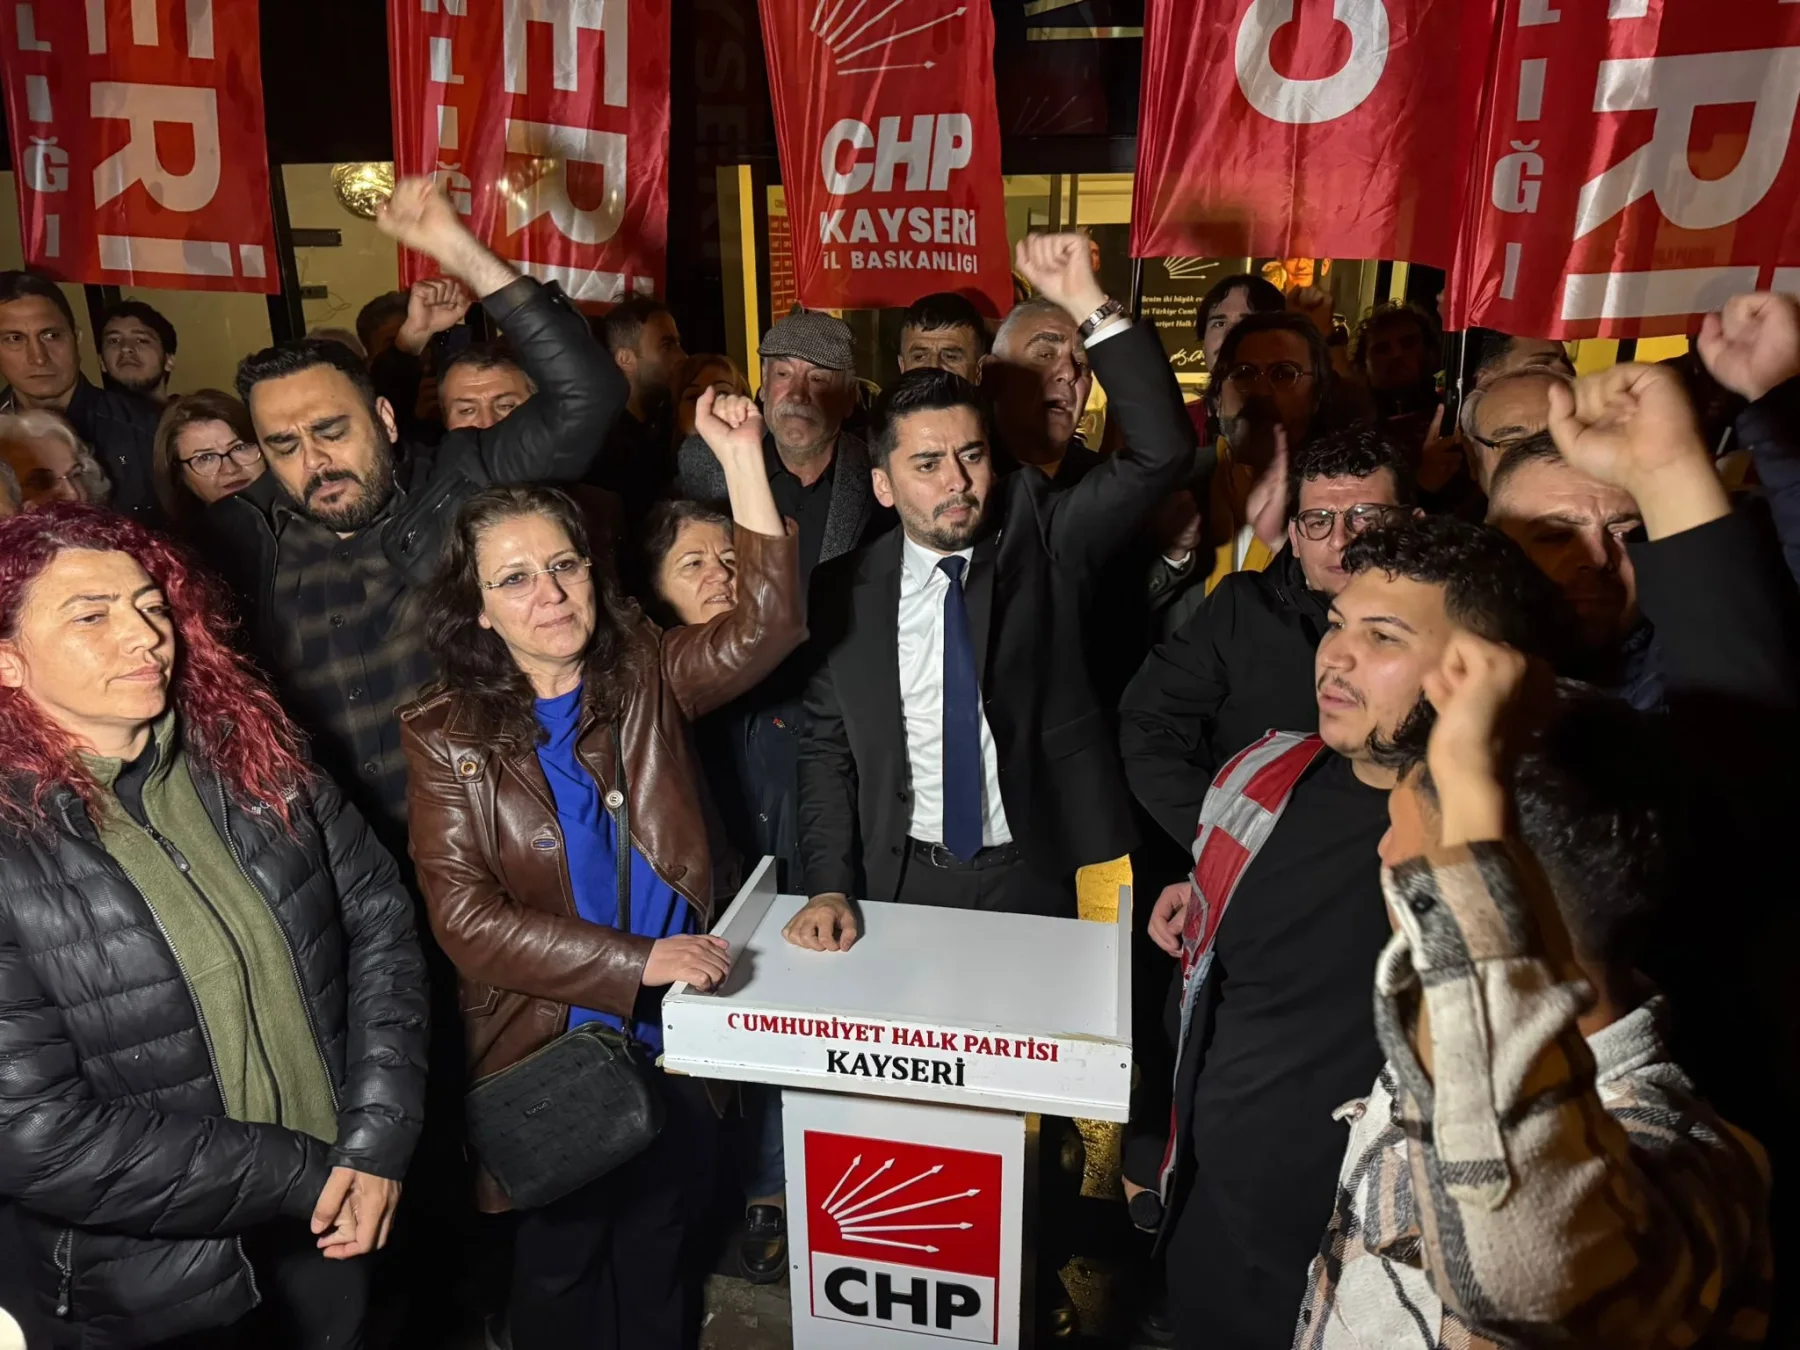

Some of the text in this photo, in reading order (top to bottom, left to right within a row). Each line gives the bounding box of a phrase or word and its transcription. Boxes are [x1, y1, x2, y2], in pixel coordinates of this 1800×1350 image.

[820, 112, 973, 196] CHP
[819, 206, 976, 246] KAYSERİ
[823, 250, 841, 270] İL
[727, 1012, 885, 1043] CUMHURİYET
[891, 1026, 958, 1052] HALK
[826, 1048, 966, 1087] KAYSERİ
[824, 1266, 982, 1330] CHP
